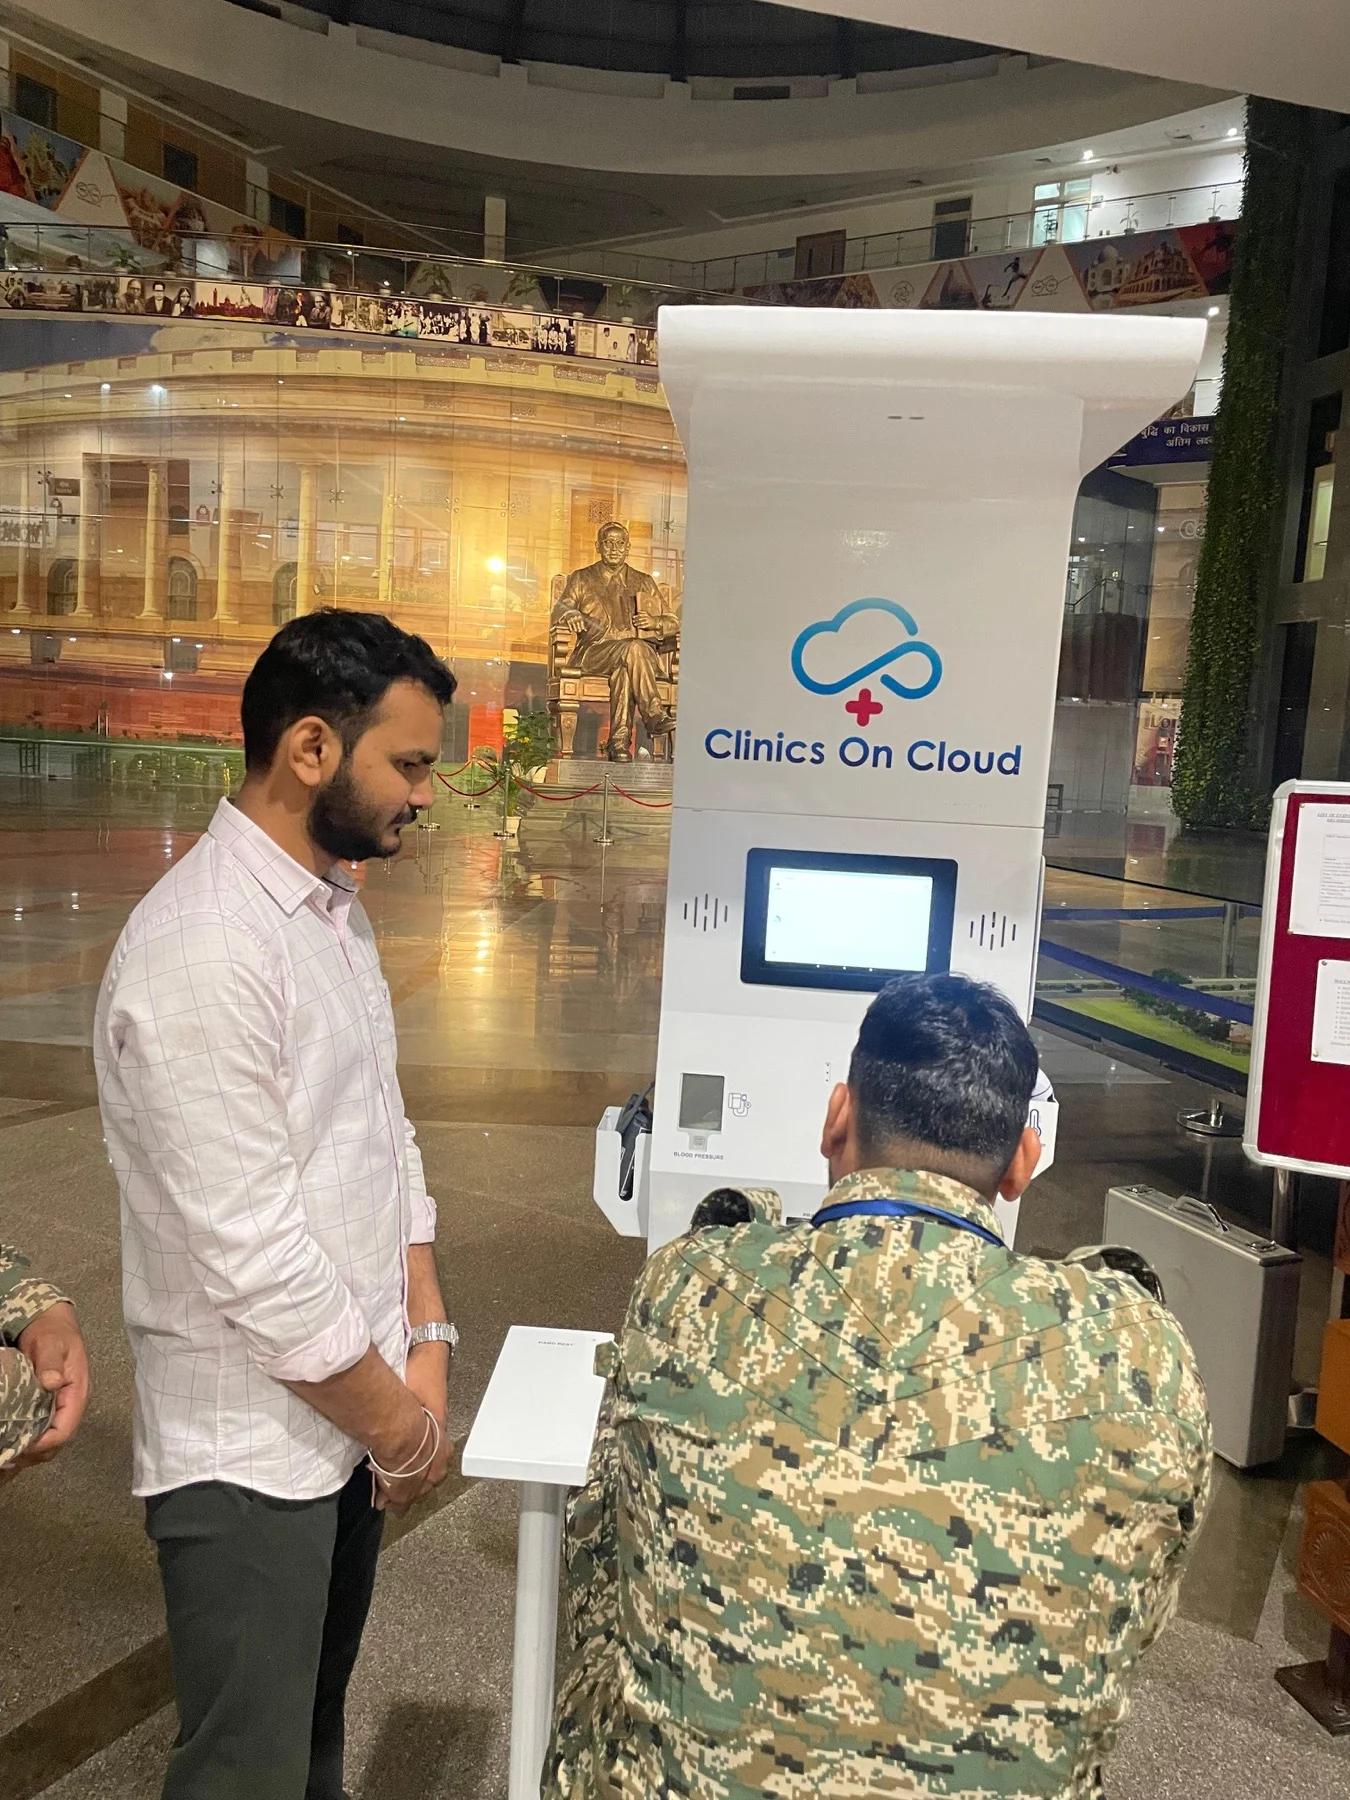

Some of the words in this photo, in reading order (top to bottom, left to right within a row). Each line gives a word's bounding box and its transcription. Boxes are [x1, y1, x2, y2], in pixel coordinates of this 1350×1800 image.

[1163, 425, 1176, 435] का
[1180, 422, 1209, 434] विकास
[1165, 436, 1192, 448] अंतिम
[704, 728, 825, 765] Clinics
[838, 736, 893, 769] On
[907, 740, 1022, 776] Cloud
